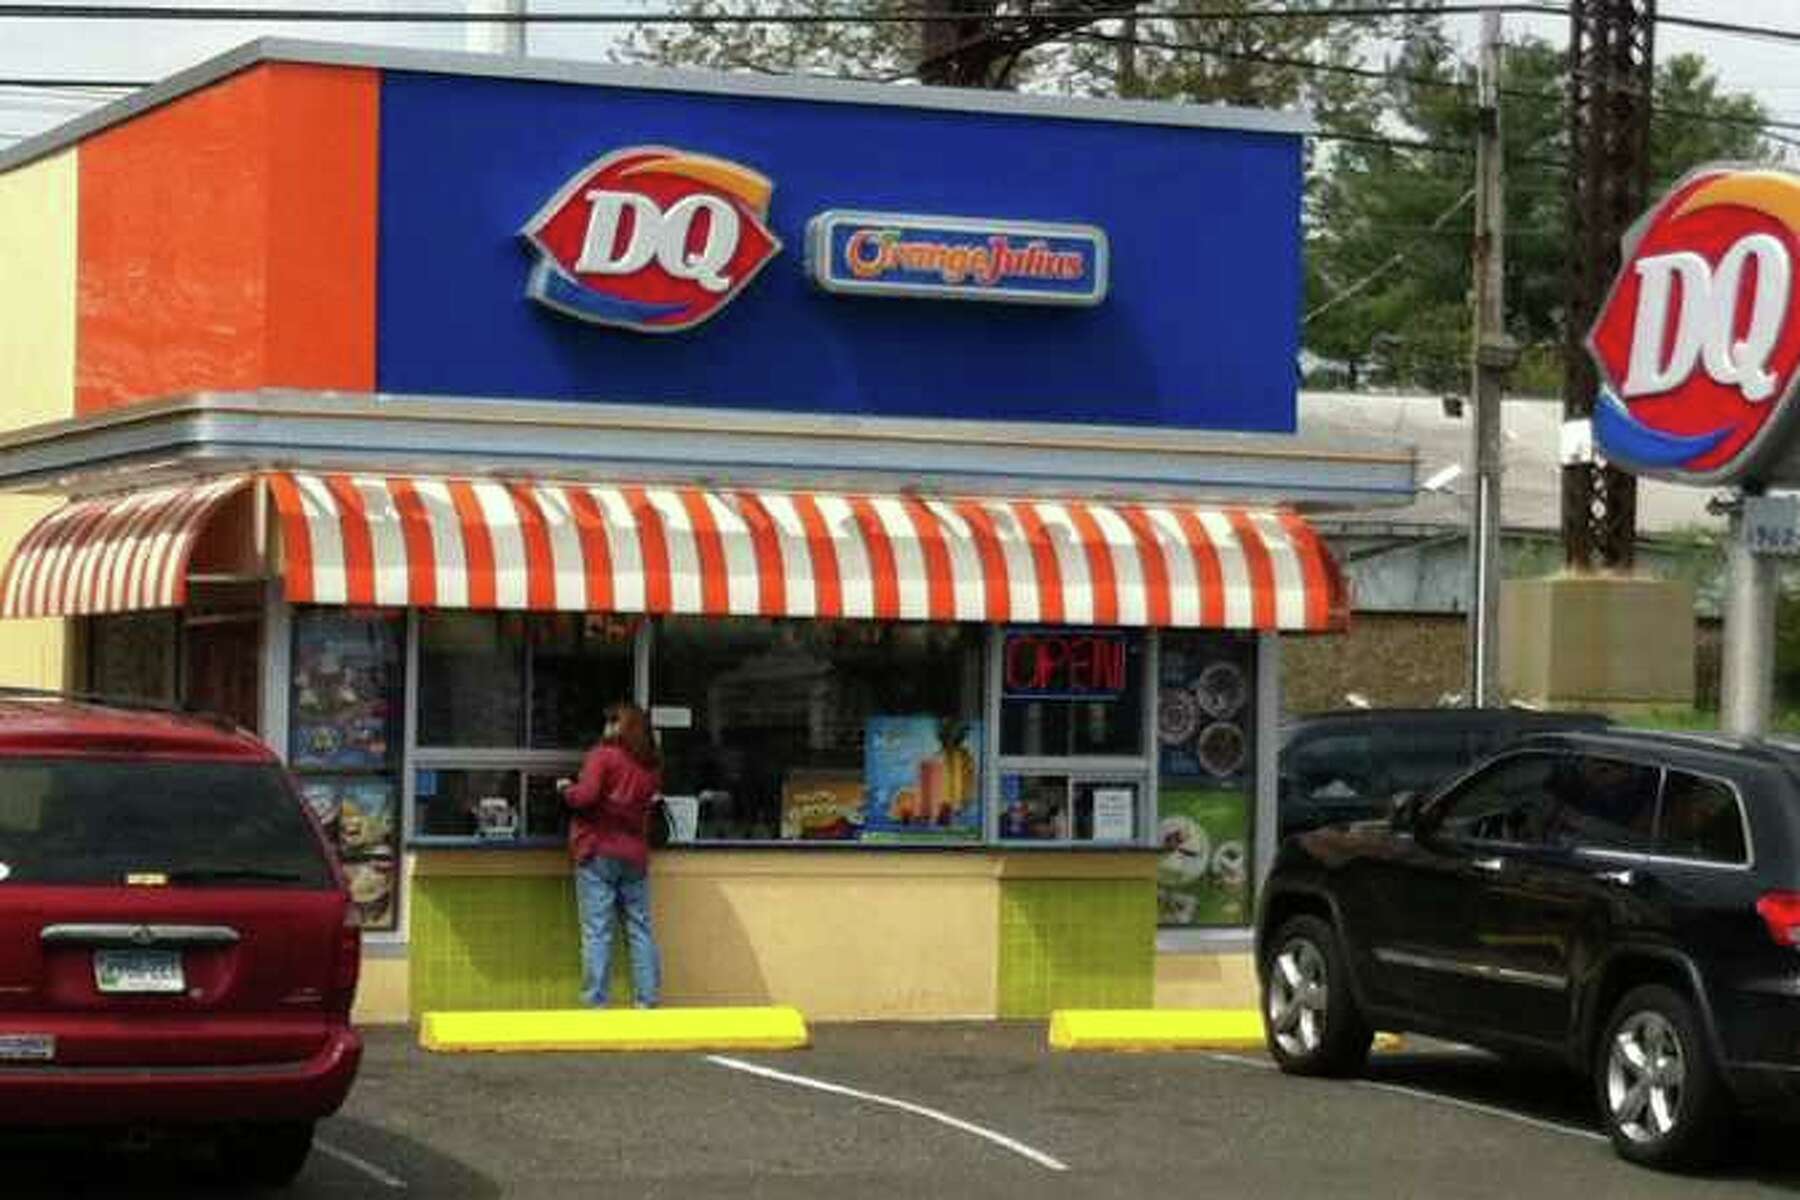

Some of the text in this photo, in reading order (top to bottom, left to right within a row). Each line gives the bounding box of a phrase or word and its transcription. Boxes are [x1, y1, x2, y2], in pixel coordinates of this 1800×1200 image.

[575, 191, 741, 291] DQ
[847, 229, 1083, 284] Orange Julius
[1623, 233, 1790, 401] DQ
[1007, 636, 1125, 688] OPEN
